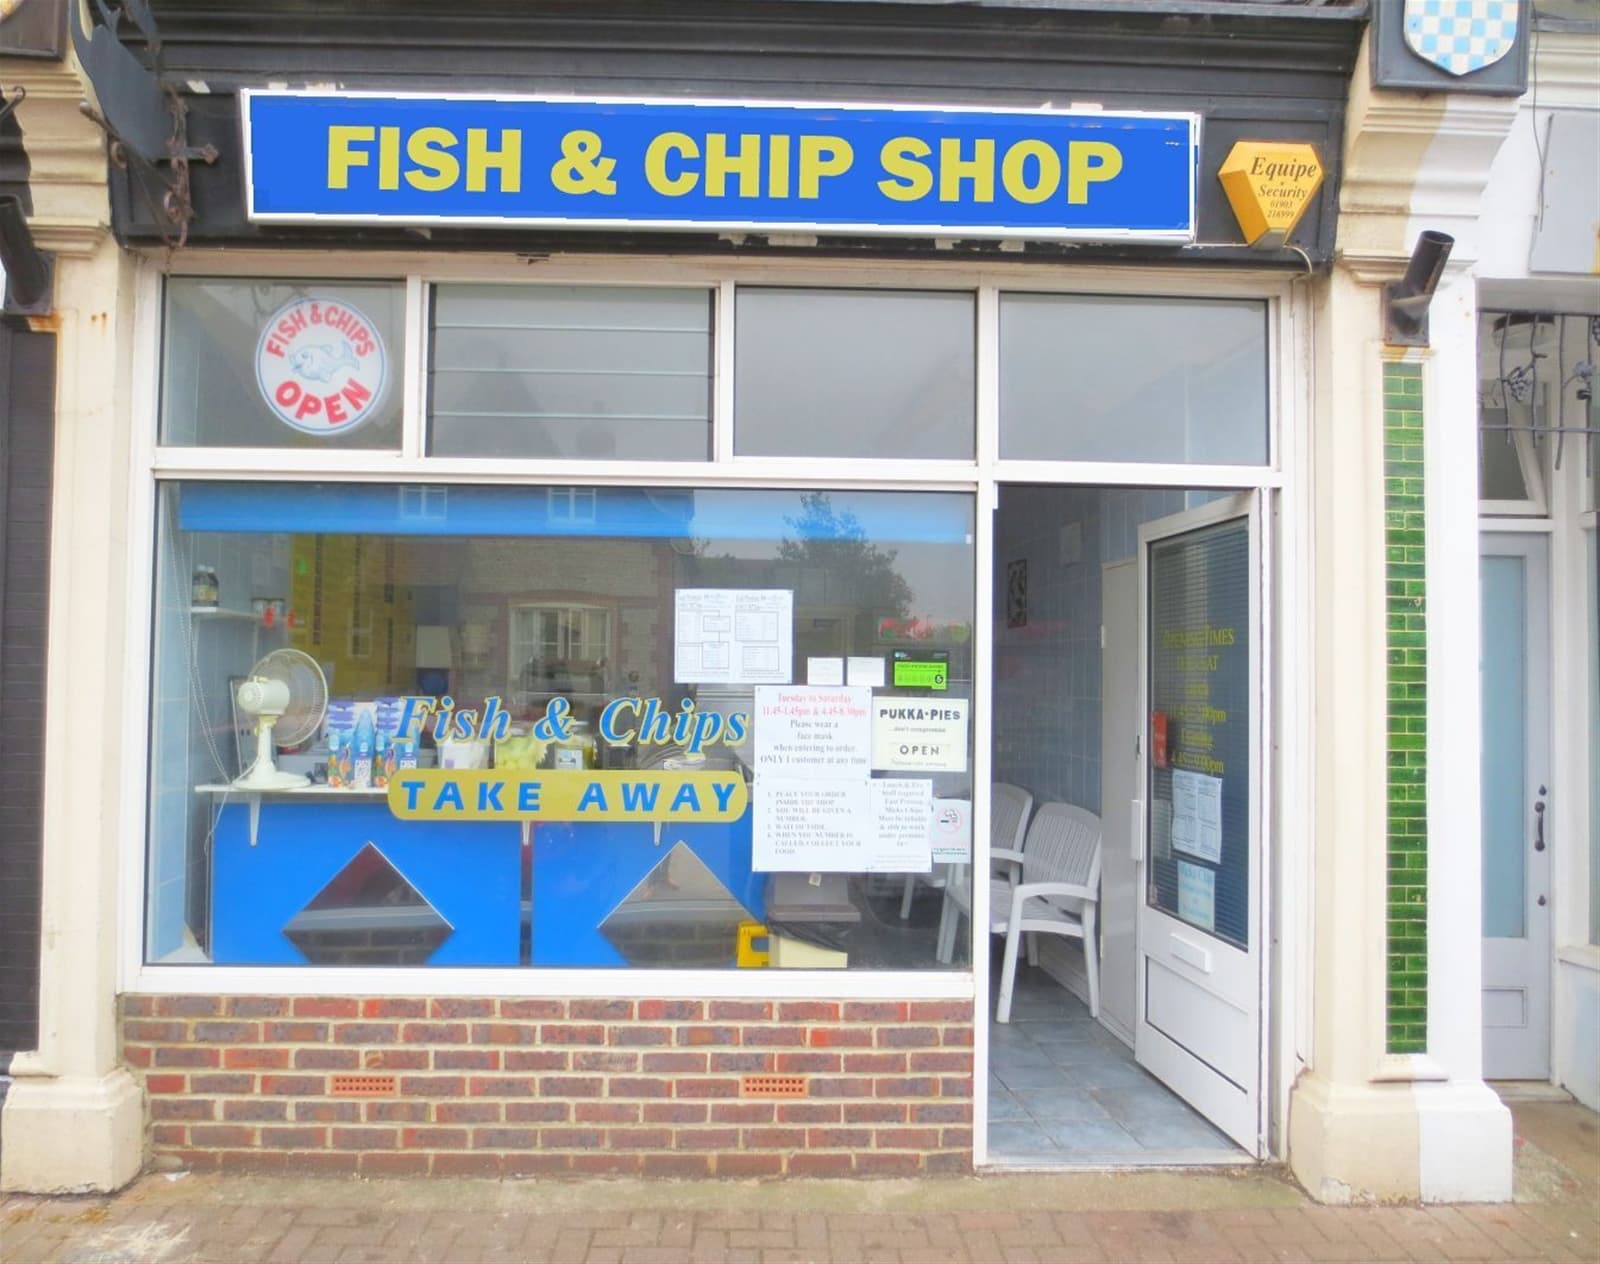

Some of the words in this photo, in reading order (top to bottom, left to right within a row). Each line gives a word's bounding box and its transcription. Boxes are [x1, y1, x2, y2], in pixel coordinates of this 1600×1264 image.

[328, 125, 523, 193] FISH
[551, 130, 617, 196] &
[645, 132, 854, 200] CHIP
[879, 137, 1123, 206] SHOP
[1250, 157, 1317, 181] Equipe
[1258, 184, 1308, 200] Security
[266, 308, 308, 358] FISH
[310, 304, 322, 325] &
[324, 305, 375, 357] CHIPS
[275, 377, 372, 424] OPEN
[778, 693, 806, 705] Tuesday
[818, 694, 852, 705] Saturday
[392, 696, 511, 744] Fish
[534, 697, 579, 744] &
[600, 697, 749, 760] Chips
[790, 719, 811, 728] Please
[797, 732, 812, 740] face
[814, 732, 832, 740] mask
[774, 743, 793, 751] when
[794, 744, 824, 753] entering
[899, 745, 940, 755] OPEN
[760, 755, 785, 764] ONLY
[792, 755, 825, 765] customer
[401, 782, 541, 811] TAKE
[577, 783, 736, 812] AWAY
